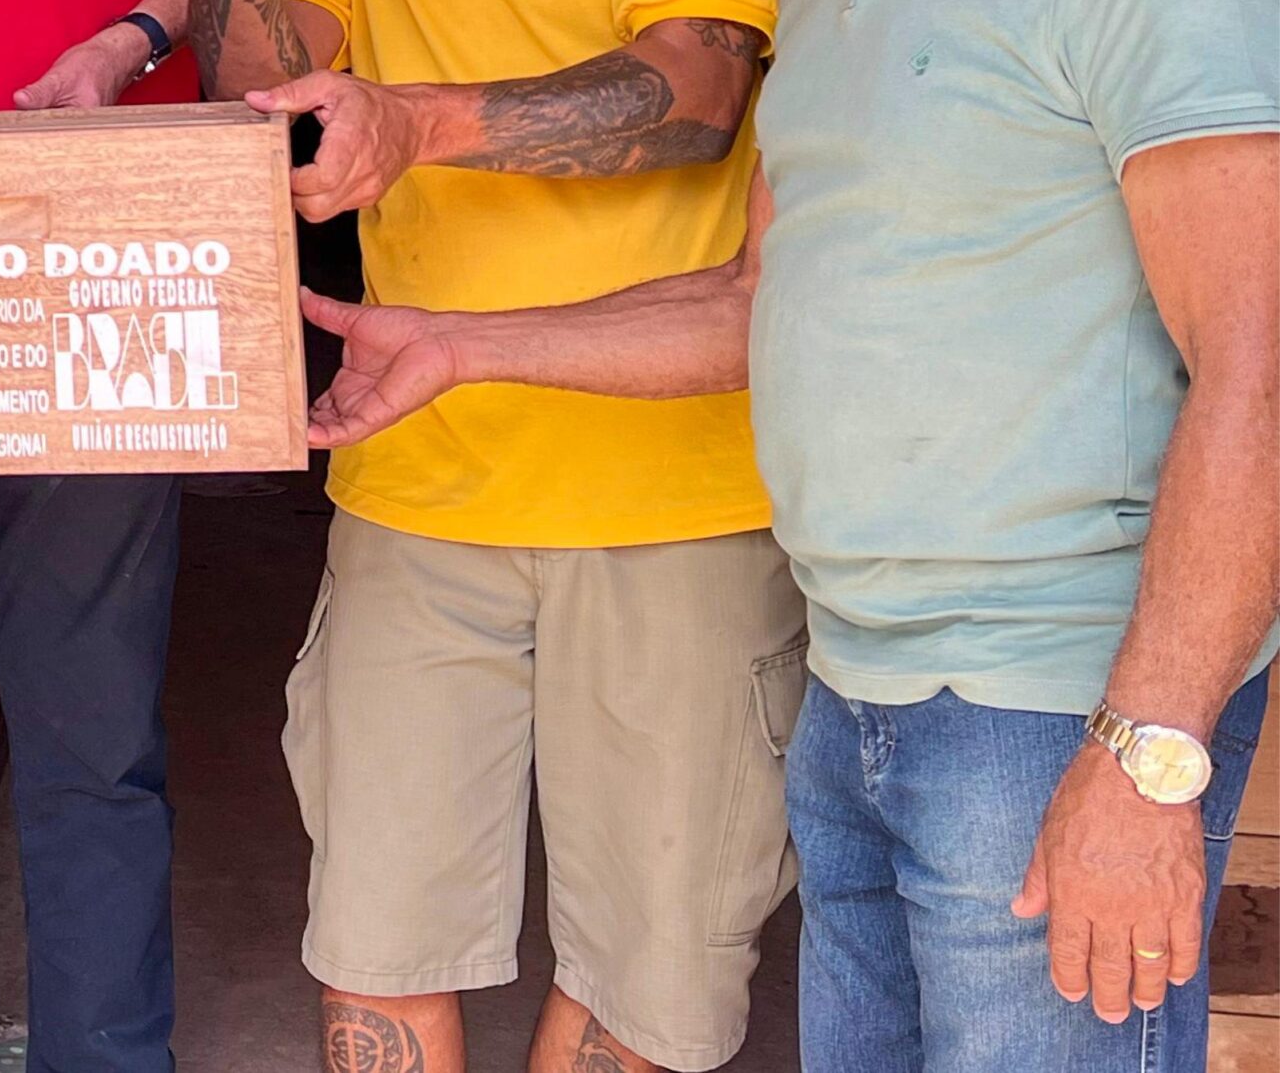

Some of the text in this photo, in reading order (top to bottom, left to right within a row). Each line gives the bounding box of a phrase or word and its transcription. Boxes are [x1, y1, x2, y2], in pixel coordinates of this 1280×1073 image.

[44, 241, 231, 277] DOADO
[70, 278, 218, 307] GOVERNO FEDERAL
[24, 298, 46, 322] DA
[12, 345, 22, 367] E
[25, 344, 47, 367] DO
[52, 310, 238, 410] BRASIL
[72, 417, 228, 457] UNIÃO E RECONSTRUÇÃO
